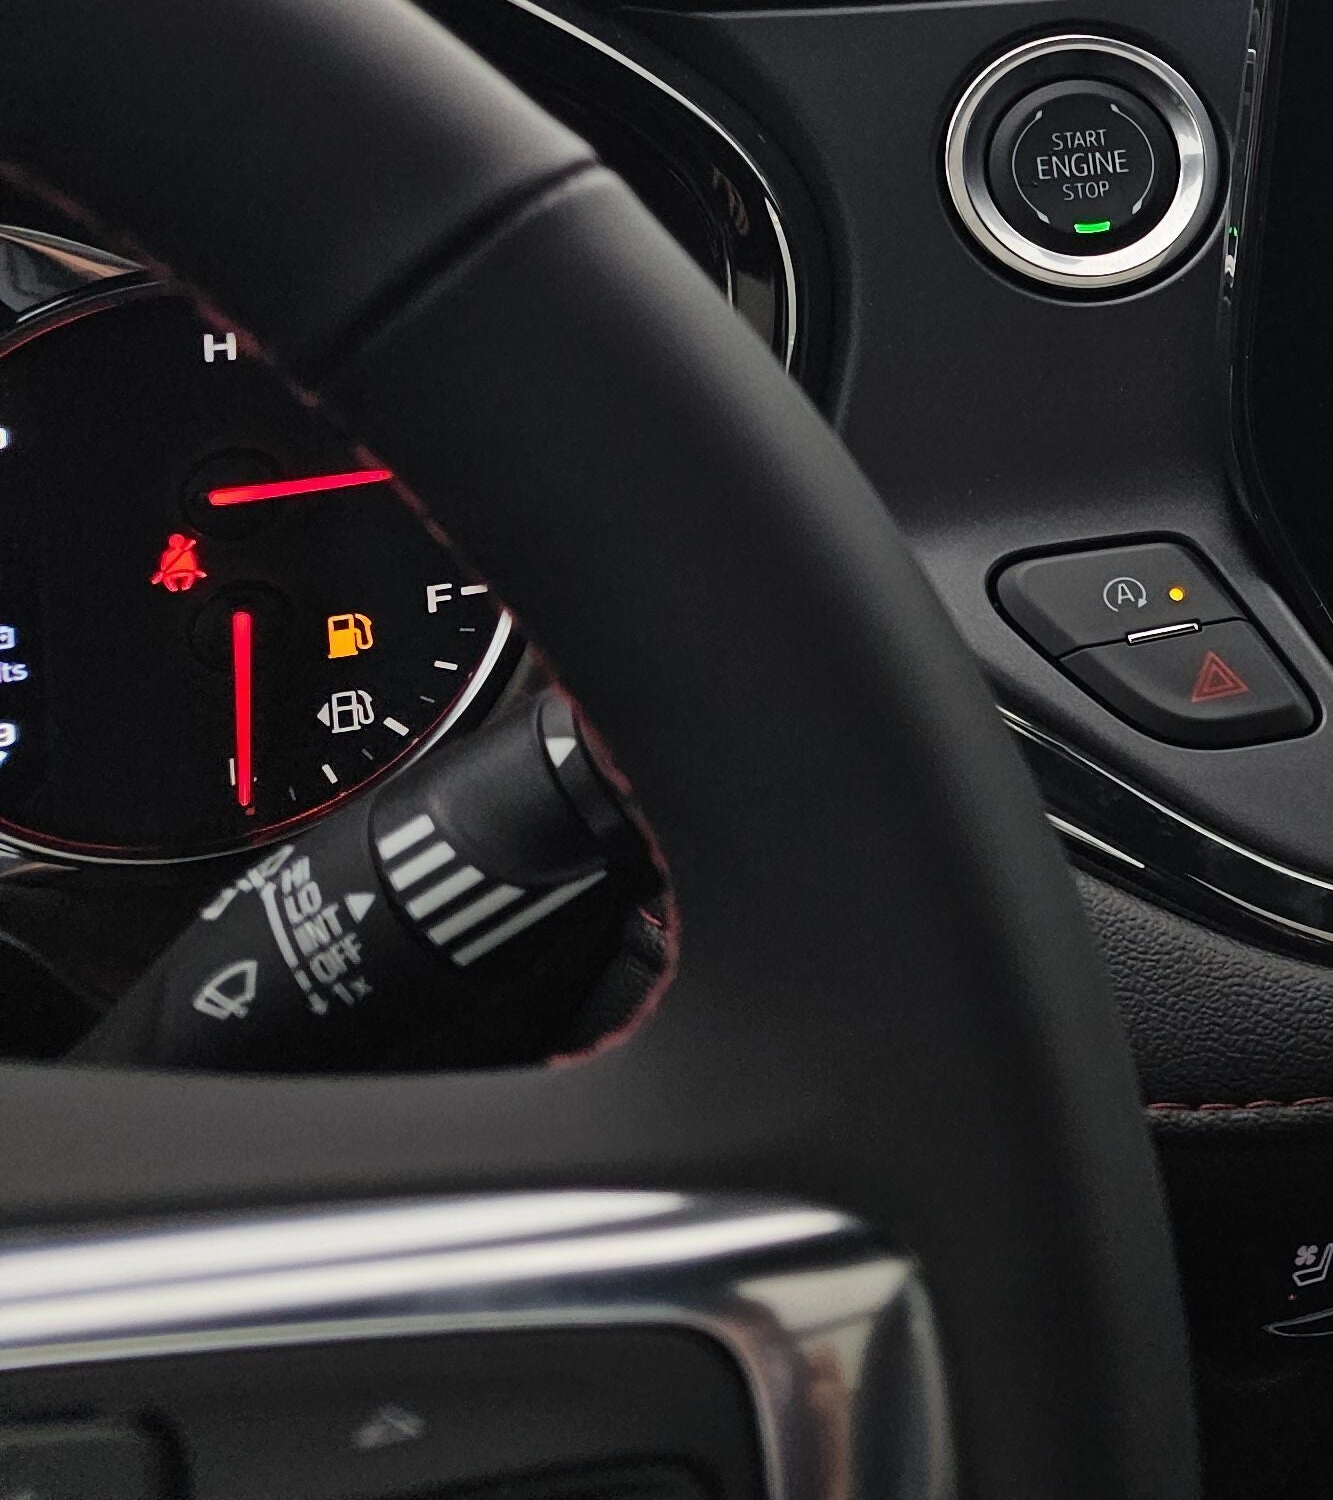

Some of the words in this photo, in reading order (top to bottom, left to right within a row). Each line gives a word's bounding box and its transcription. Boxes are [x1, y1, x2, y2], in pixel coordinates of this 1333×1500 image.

[1051, 129, 1107, 150] START
[1036, 149, 1129, 180] ENGINE
[1062, 180, 1110, 201] STOP
[202, 332, 237, 363] H
[426, 583, 452, 613] F
